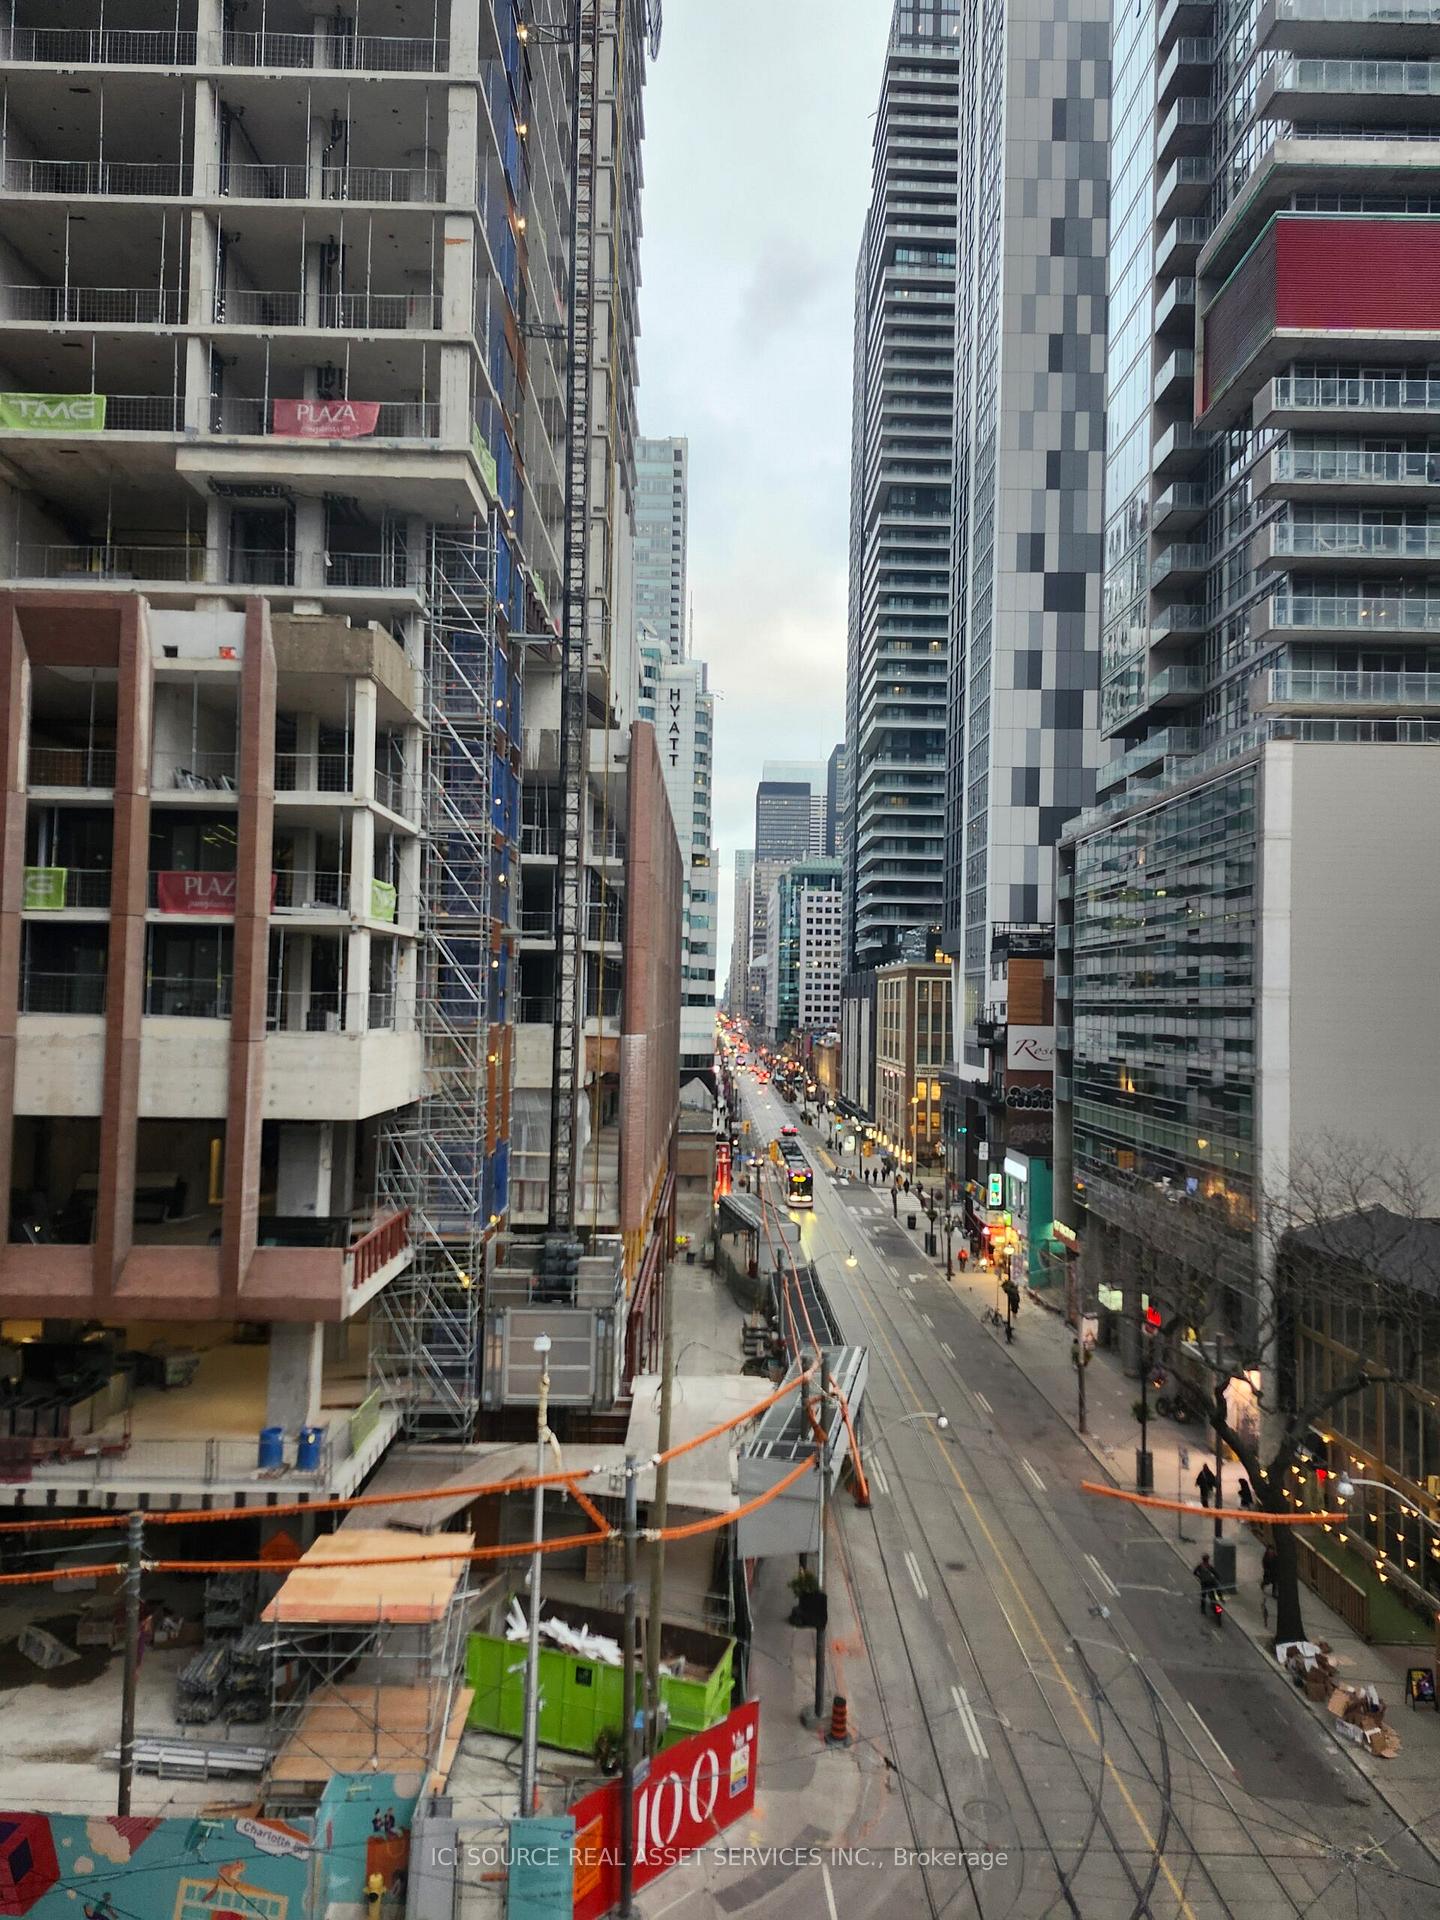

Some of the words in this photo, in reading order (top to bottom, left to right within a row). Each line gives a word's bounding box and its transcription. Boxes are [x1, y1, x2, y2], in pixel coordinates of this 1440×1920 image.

[9, 400, 95, 419] TMG
[297, 403, 356, 422] PLAZA
[669, 688, 680, 767] HYATT
[184, 876, 236, 897] PLAZ
[636, 1749, 719, 1863] 100
